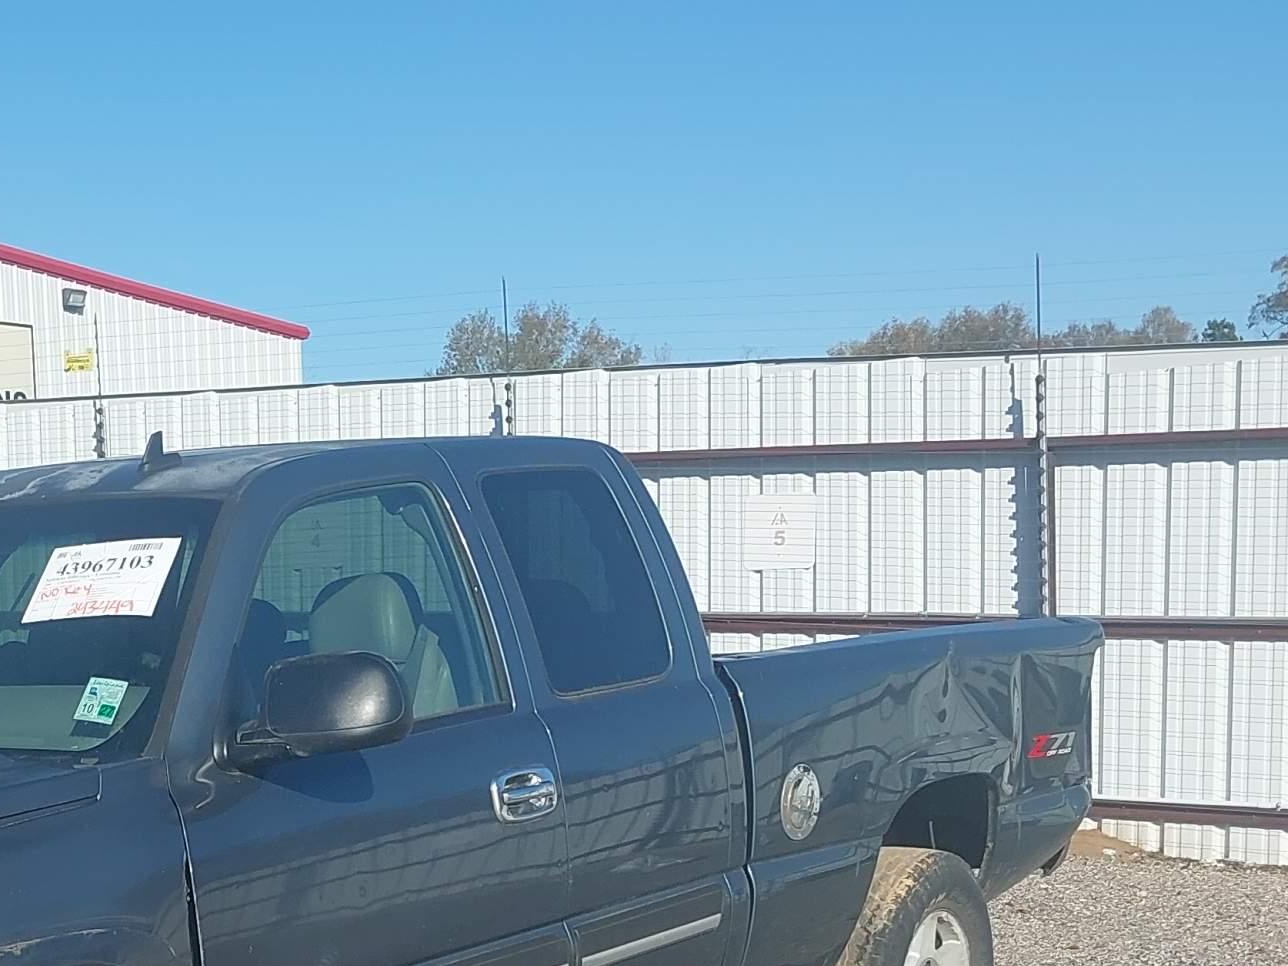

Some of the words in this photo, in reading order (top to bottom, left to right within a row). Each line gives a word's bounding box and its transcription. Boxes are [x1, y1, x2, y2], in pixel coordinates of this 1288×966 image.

[773, 530, 786, 546] 5
[56, 555, 155, 577] 43967103
[82, 703, 95, 714] 10
[1027, 731, 1076, 758] Z71
